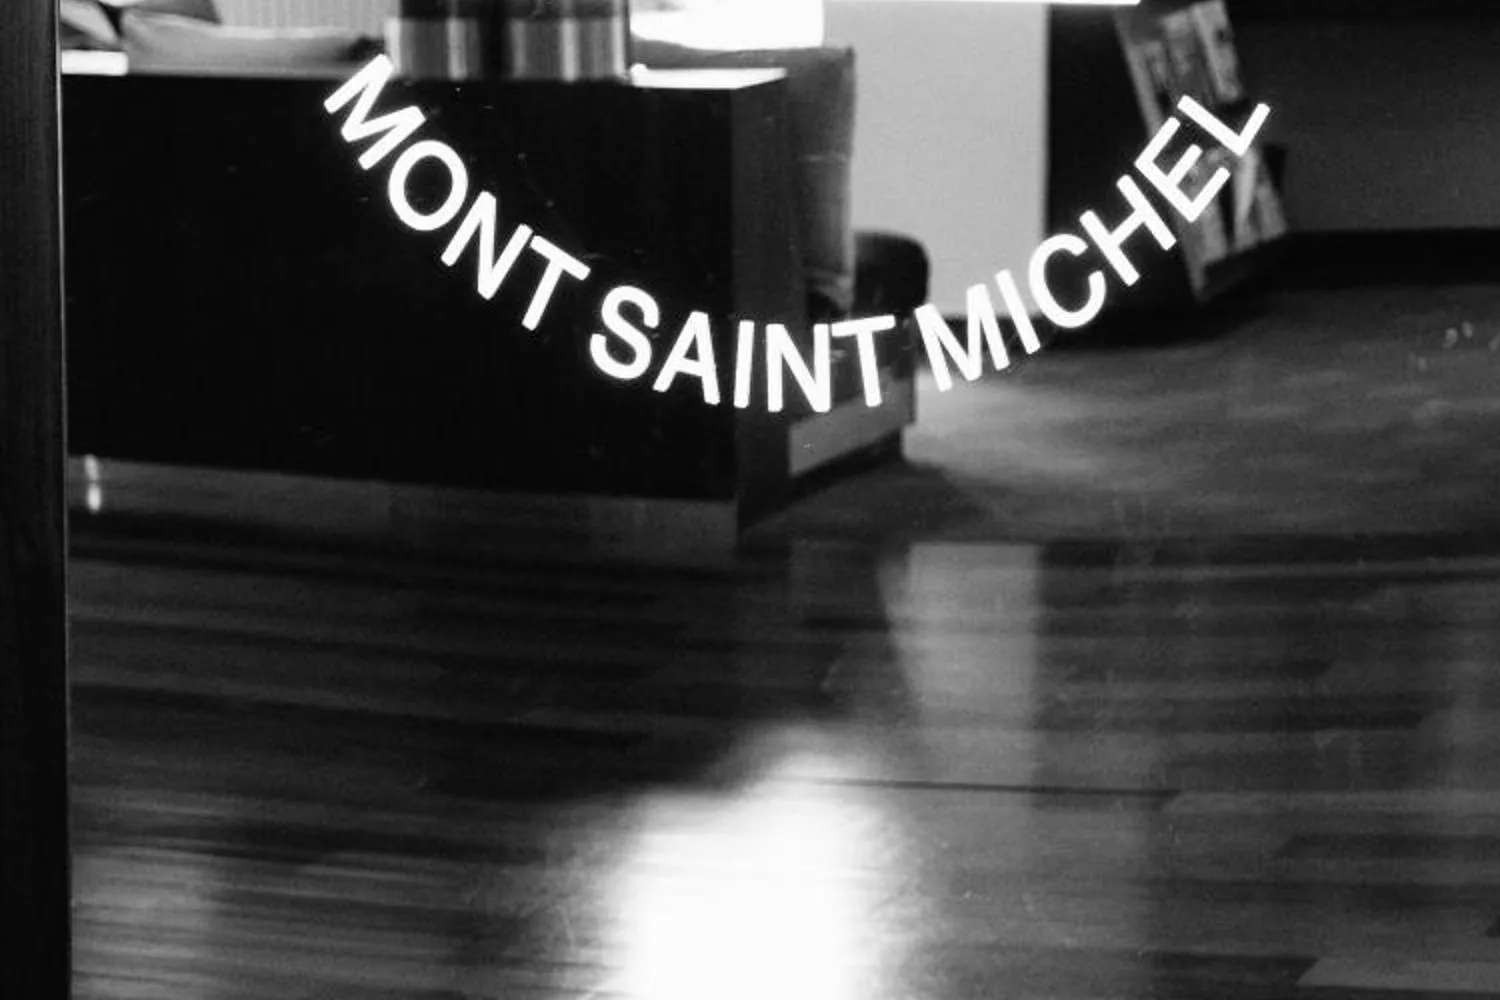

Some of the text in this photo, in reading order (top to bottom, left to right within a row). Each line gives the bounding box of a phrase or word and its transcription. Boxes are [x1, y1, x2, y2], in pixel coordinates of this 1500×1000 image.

[324, 54, 1271, 413] MONT SAINT MICHEL
